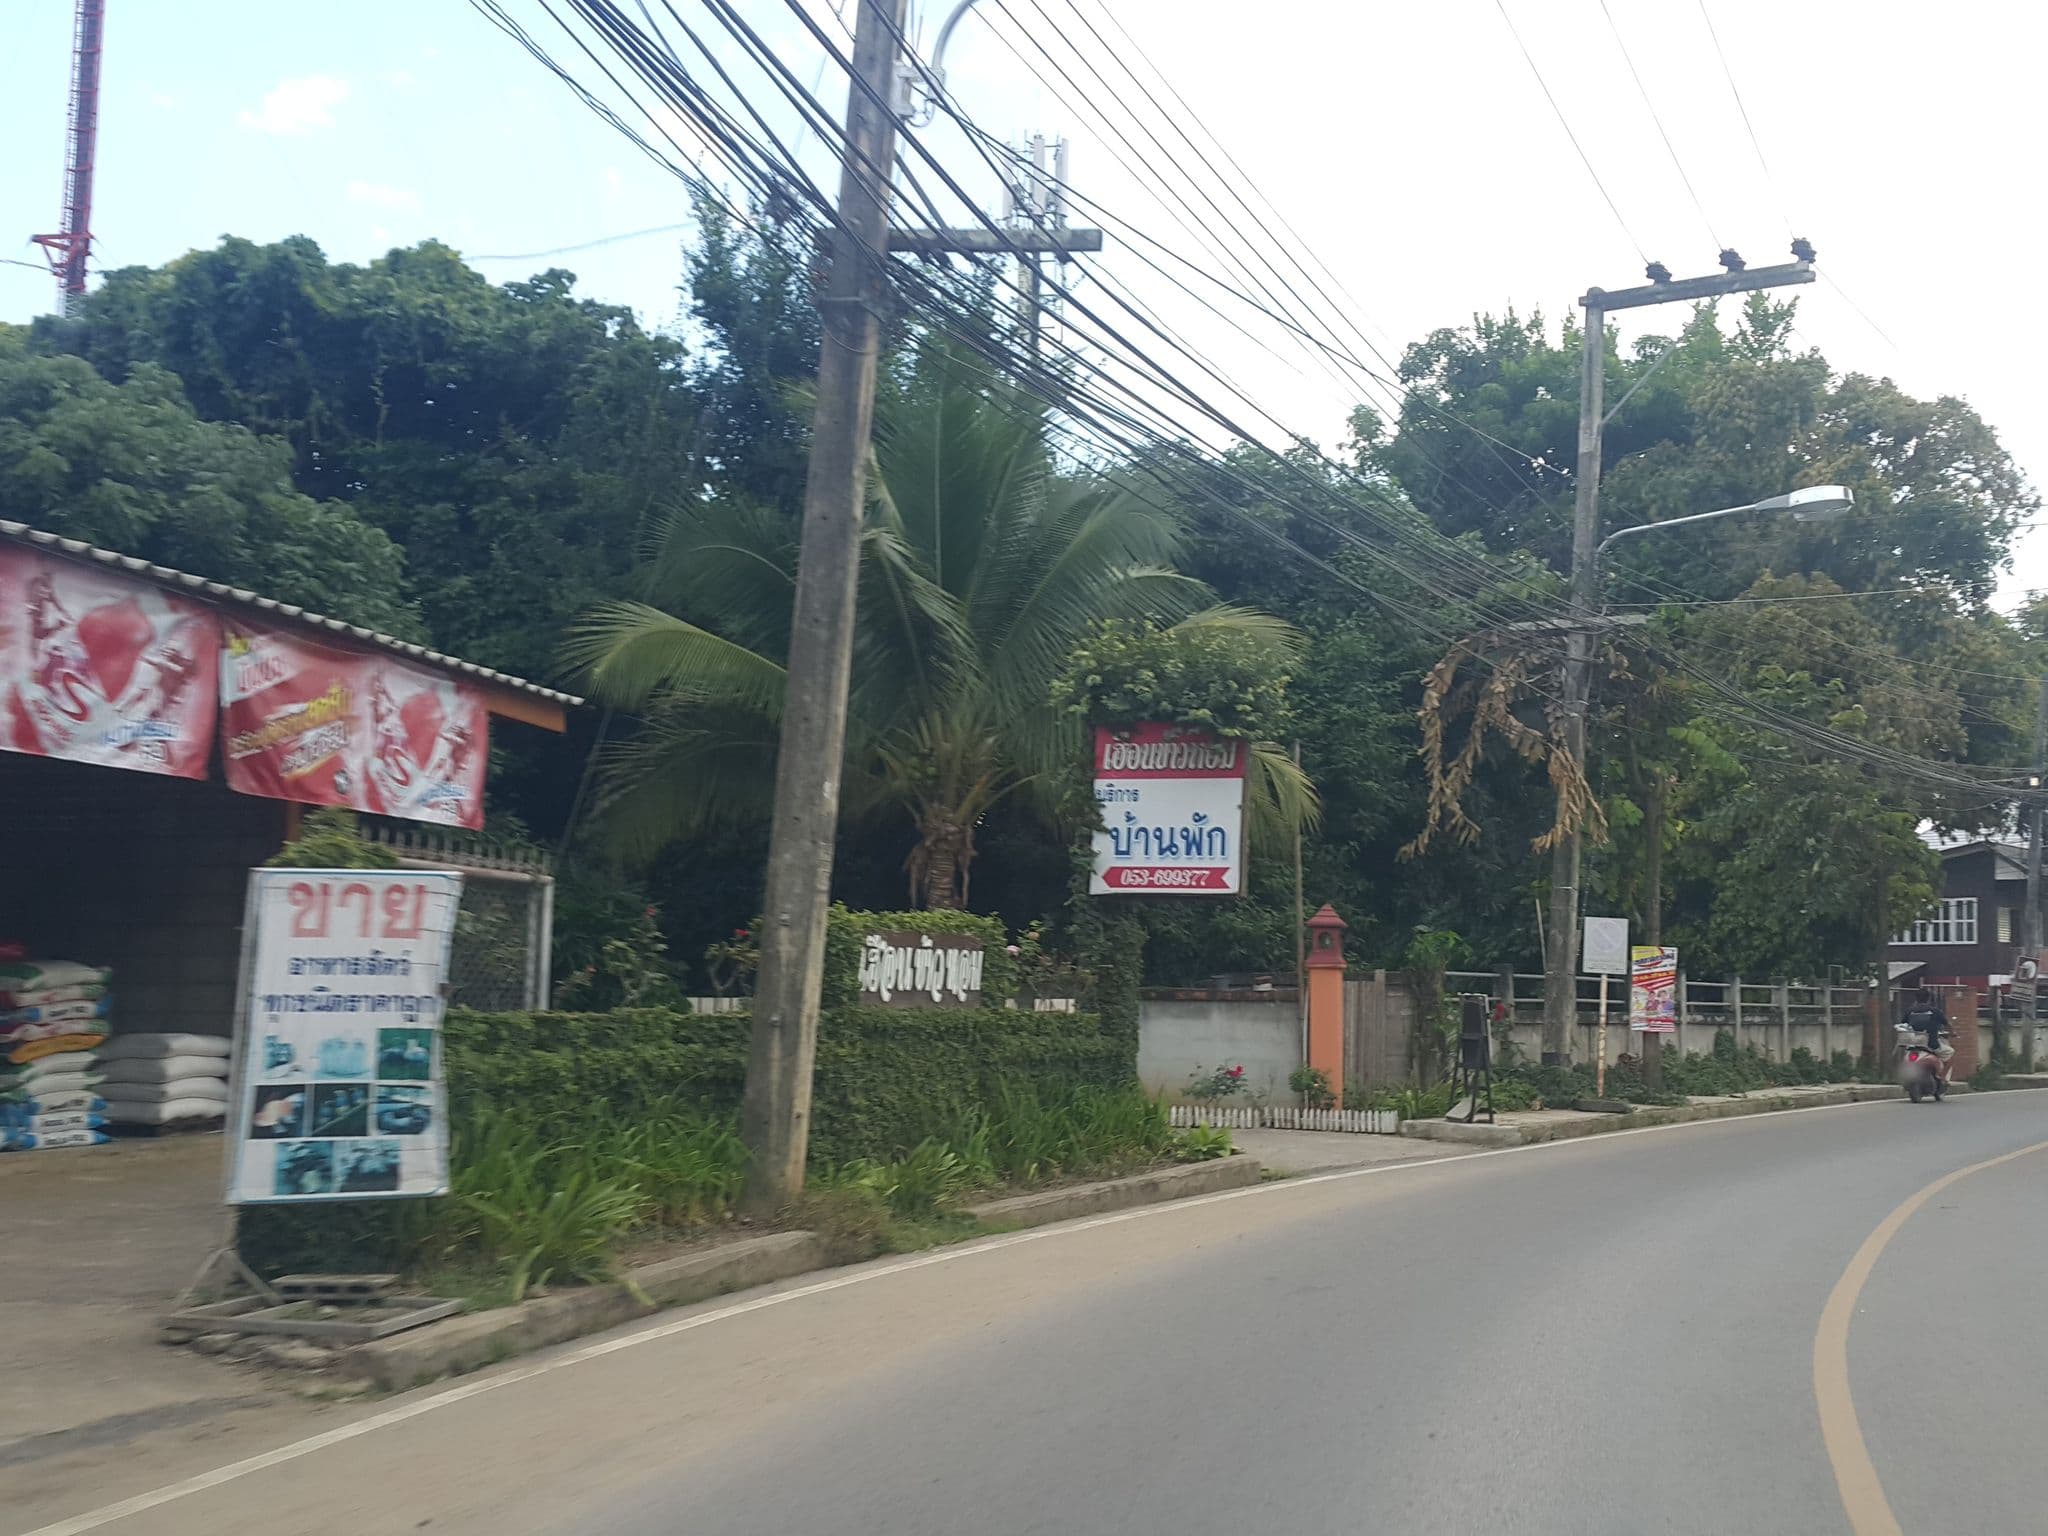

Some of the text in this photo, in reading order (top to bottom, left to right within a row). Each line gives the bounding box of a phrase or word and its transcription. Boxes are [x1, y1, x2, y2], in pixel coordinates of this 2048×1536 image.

[1096, 782, 1140, 802] บริการ
[1109, 810, 1227, 858] บ้านพัก
[287, 879, 429, 939] ขาย
